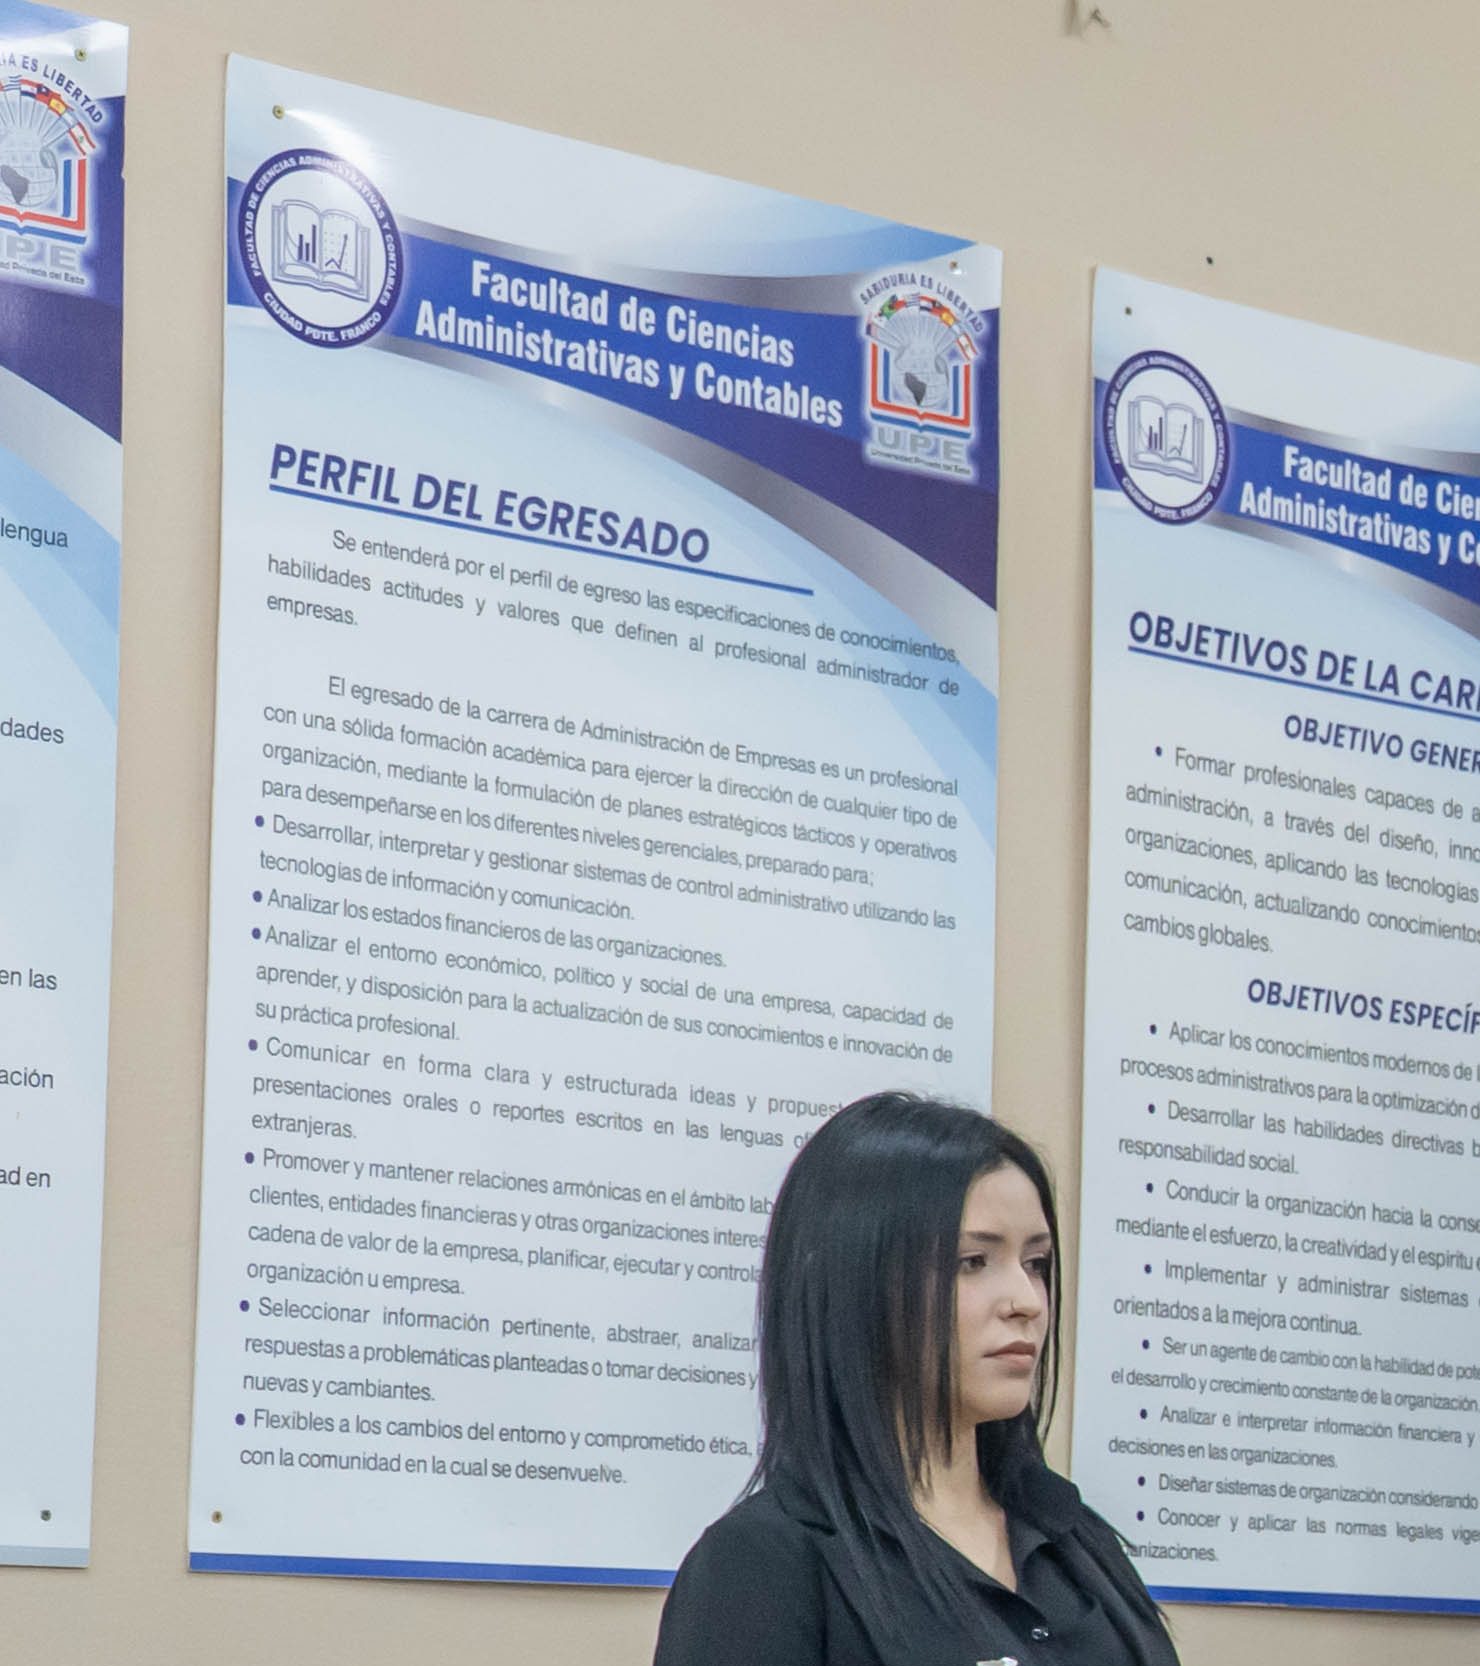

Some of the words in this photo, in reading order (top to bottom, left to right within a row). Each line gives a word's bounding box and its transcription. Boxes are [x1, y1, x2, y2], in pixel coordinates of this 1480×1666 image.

[472, 260, 608, 325] Facultad
[620, 296, 655, 335] de
[667, 306, 793, 367] Ciencias
[416, 304, 659, 387] Administrativas
[669, 364, 685, 398] y
[696, 362, 842, 427] Contables
[877, 427, 965, 463] UPE
[1284, 445, 1391, 500] Facultad
[1399, 474, 1428, 508] de
[271, 444, 400, 504] PERFIL
[413, 474, 482, 521] DEL
[495, 490, 709, 563] EGRESADO
[1240, 482, 1430, 554] Administrativas
[1438, 534, 1451, 562] y
[267, 596, 357, 624] empresas.
[1130, 611, 1307, 676] OBJETIVOS
[1317, 650, 1357, 686] DE
[1365, 660, 1399, 695] LA
[1285, 715, 1403, 758] OBJETIVO
[1176, 747, 1235, 776] Formar
[1244, 765, 1356, 800] profesionales
[1365, 788, 1434, 814] capaces
[1443, 798, 1463, 819] de
[1124, 913, 1195, 940] cambios
[1198, 923, 1272, 952] globales.
[29, 968, 57, 990] las
[1248, 979, 1382, 1020] OBJETIVOS
[252, 1114, 356, 1138] extranjeras.
[1119, 1139, 1245, 1168] responsabilidad
[1249, 1154, 1298, 1174] social.
[26, 1172, 50, 1187] en
[240, 1450, 274, 1465] con
[280, 1448, 294, 1466] la
[298, 1452, 400, 1472] comunidad
[405, 1459, 427, 1473] en
[432, 1456, 446, 1474] la
[450, 1458, 487, 1476] cual
[492, 1463, 511, 1478] se
[515, 1460, 626, 1483] desenvuelve.
